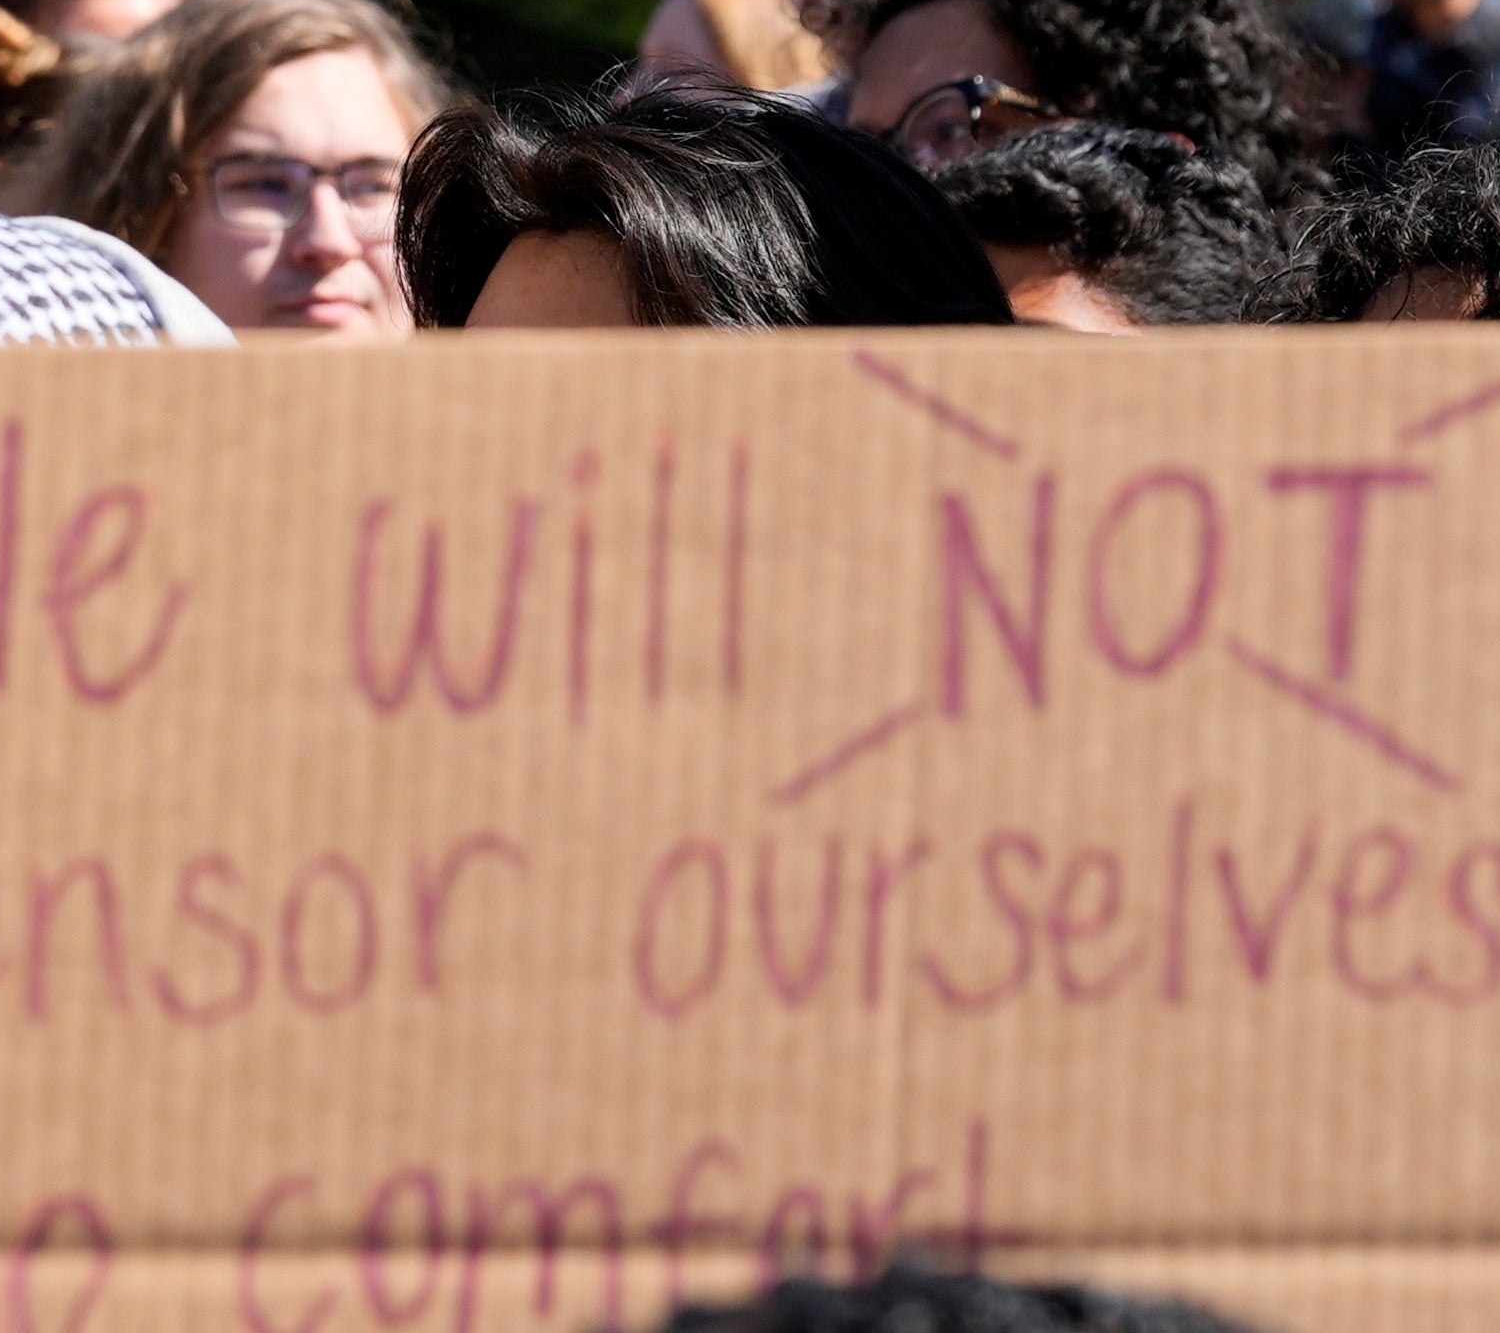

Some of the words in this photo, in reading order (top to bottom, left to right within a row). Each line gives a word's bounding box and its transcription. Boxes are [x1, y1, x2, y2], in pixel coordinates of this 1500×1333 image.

[355, 441, 750, 728] will
[931, 461, 1437, 720] NOT
[238, 1117, 1028, 1333] comfort
